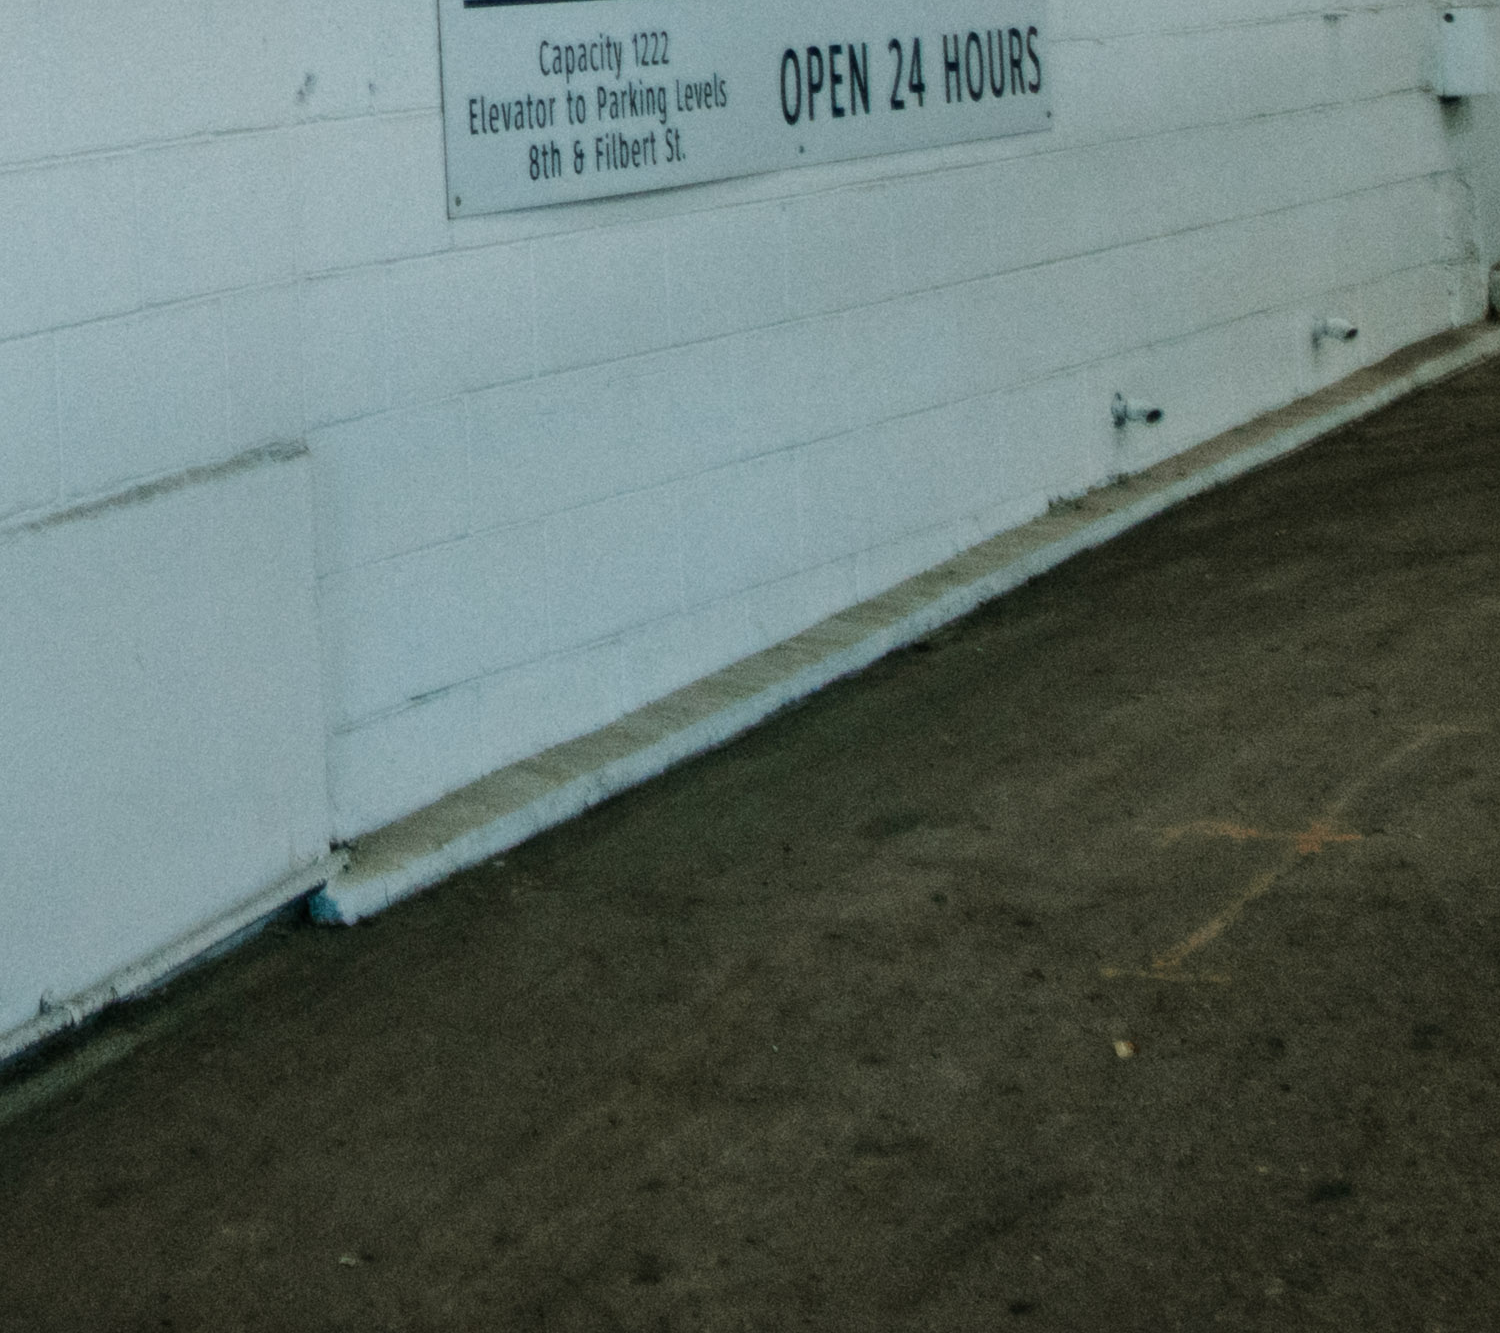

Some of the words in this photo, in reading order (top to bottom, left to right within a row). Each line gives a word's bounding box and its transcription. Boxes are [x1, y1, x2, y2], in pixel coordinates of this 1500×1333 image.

[538, 33, 623, 85] Capacity
[632, 30, 671, 69] 1222
[780, 40, 870, 125] OPEN
[888, 38, 926, 112] 24
[943, 25, 1042, 104] HOURS
[468, 90, 556, 136] Elevator
[566, 87, 588, 124] to
[597, 81, 669, 127] Parking
[675, 72, 729, 115] Levels
[528, 140, 563, 182] 8th
[572, 139, 585, 175] &
[595, 129, 658, 173] Filbert
[665, 129, 687, 164] St.
